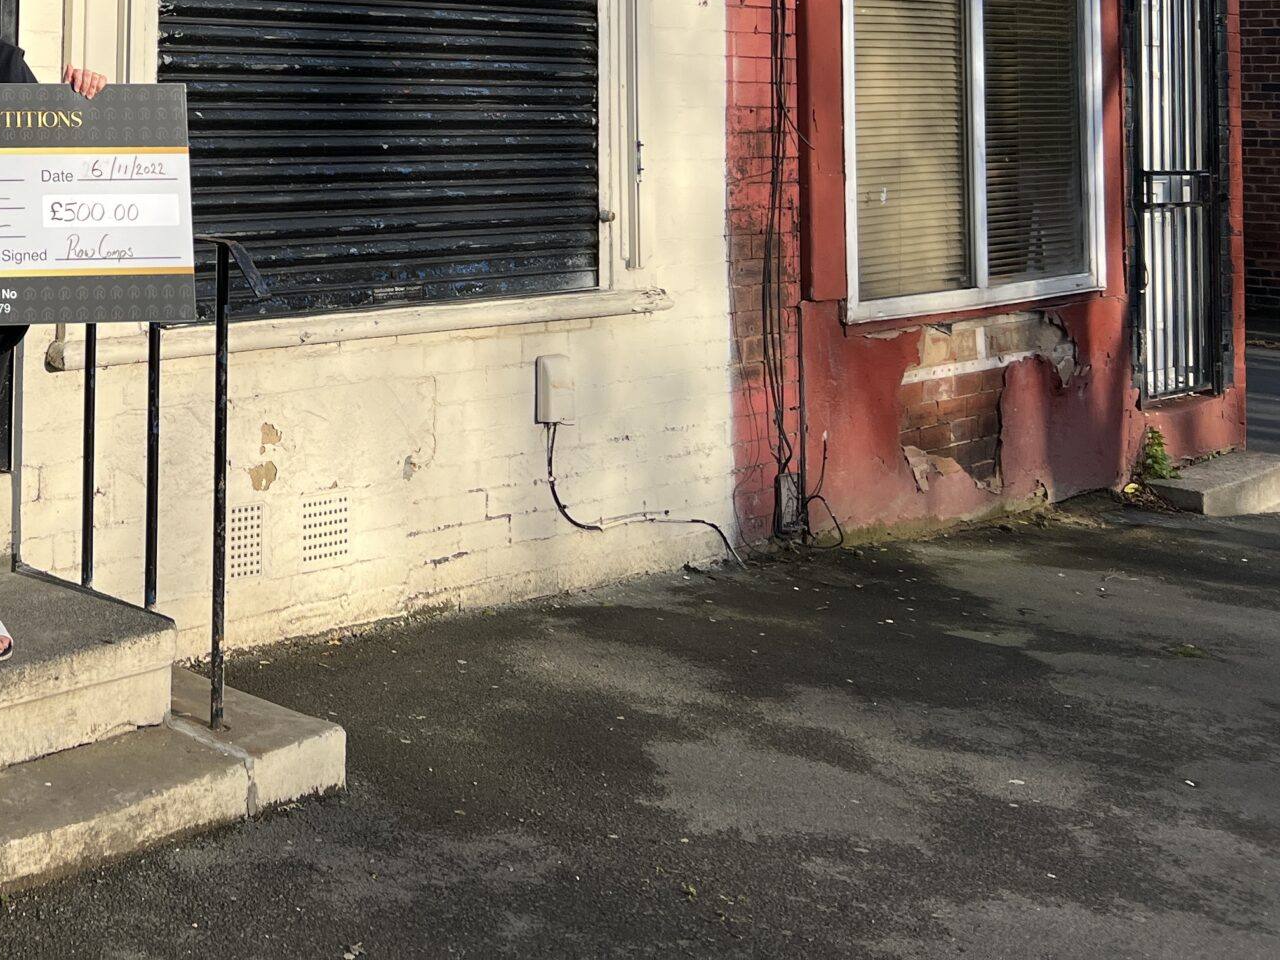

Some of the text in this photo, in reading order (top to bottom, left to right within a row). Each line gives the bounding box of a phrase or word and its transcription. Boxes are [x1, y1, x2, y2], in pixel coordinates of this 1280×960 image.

[41, 169, 74, 183] Date
[1, 249, 47, 264] Signed
[1, 288, 17, 299] No
